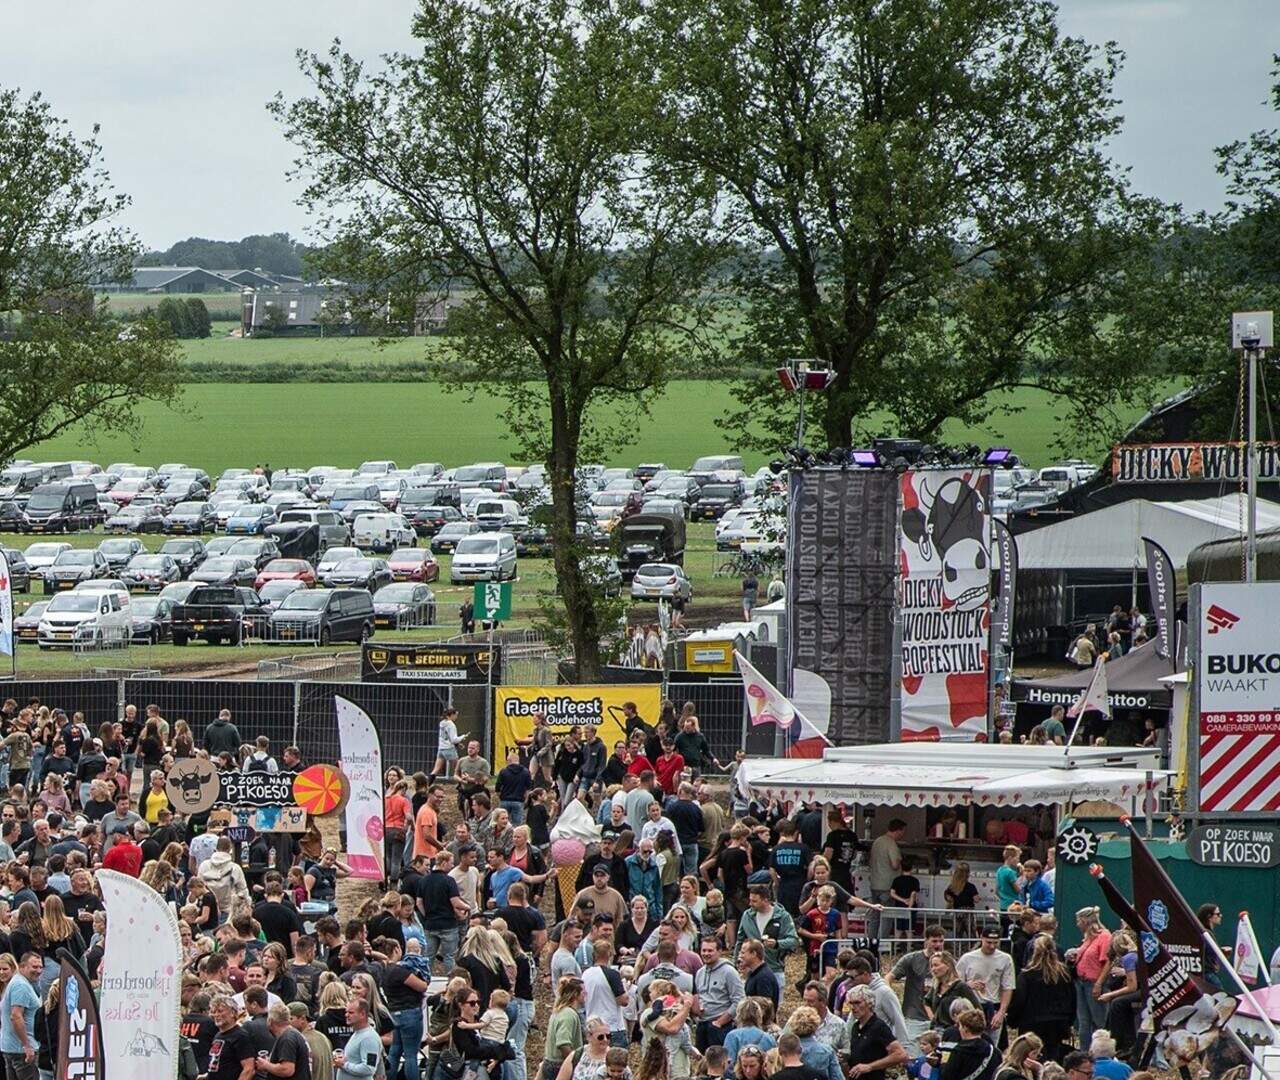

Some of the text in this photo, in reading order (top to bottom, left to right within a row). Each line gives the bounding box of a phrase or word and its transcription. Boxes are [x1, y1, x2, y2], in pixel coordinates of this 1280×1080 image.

[1117, 447, 1193, 482] DICKY
[904, 577, 943, 609] DICKY
[903, 608, 984, 642] WOODSTOCK
[396, 655, 412, 665] GL
[415, 655, 467, 665] SECURITY
[1207, 654, 1280, 675] BUKO
[1207, 679, 1269, 692] WAAKT
[1107, 692, 1147, 707] attoo
[546, 714, 602, 725] Oudehorne
[1206, 714, 1226, 723] 088
[1236, 714, 1255, 723] 330
[1258, 714, 1271, 722] 99
[220, 776, 292, 786] OP ZOEK NAAR
[226, 785, 289, 800] PIKOESO
[1206, 829, 1274, 843] OP ZOEK NAAR
[1200, 840, 1271, 864] PIKOESO
[180, 1022, 200, 1036] HV
